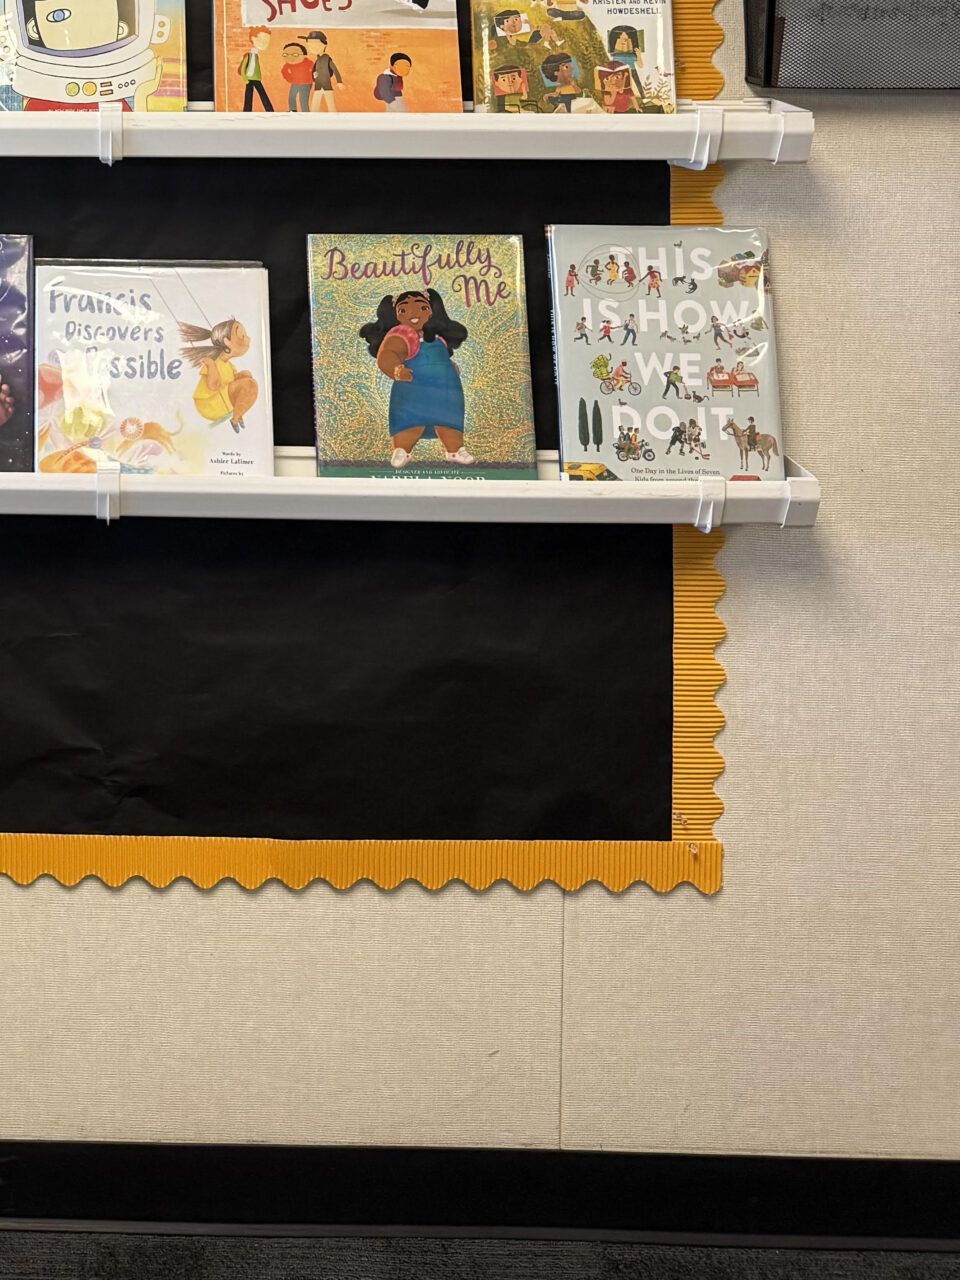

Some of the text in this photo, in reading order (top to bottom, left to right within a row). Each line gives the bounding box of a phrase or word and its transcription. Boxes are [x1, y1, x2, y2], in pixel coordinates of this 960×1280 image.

[320, 240, 502, 286] Beautifully
[609, 246, 713, 281] THIS
[451, 274, 511, 307] Me
[582, 298, 749, 333] IS HOW
[634, 351, 703, 386] WE
[611, 405, 734, 441] DO IT
